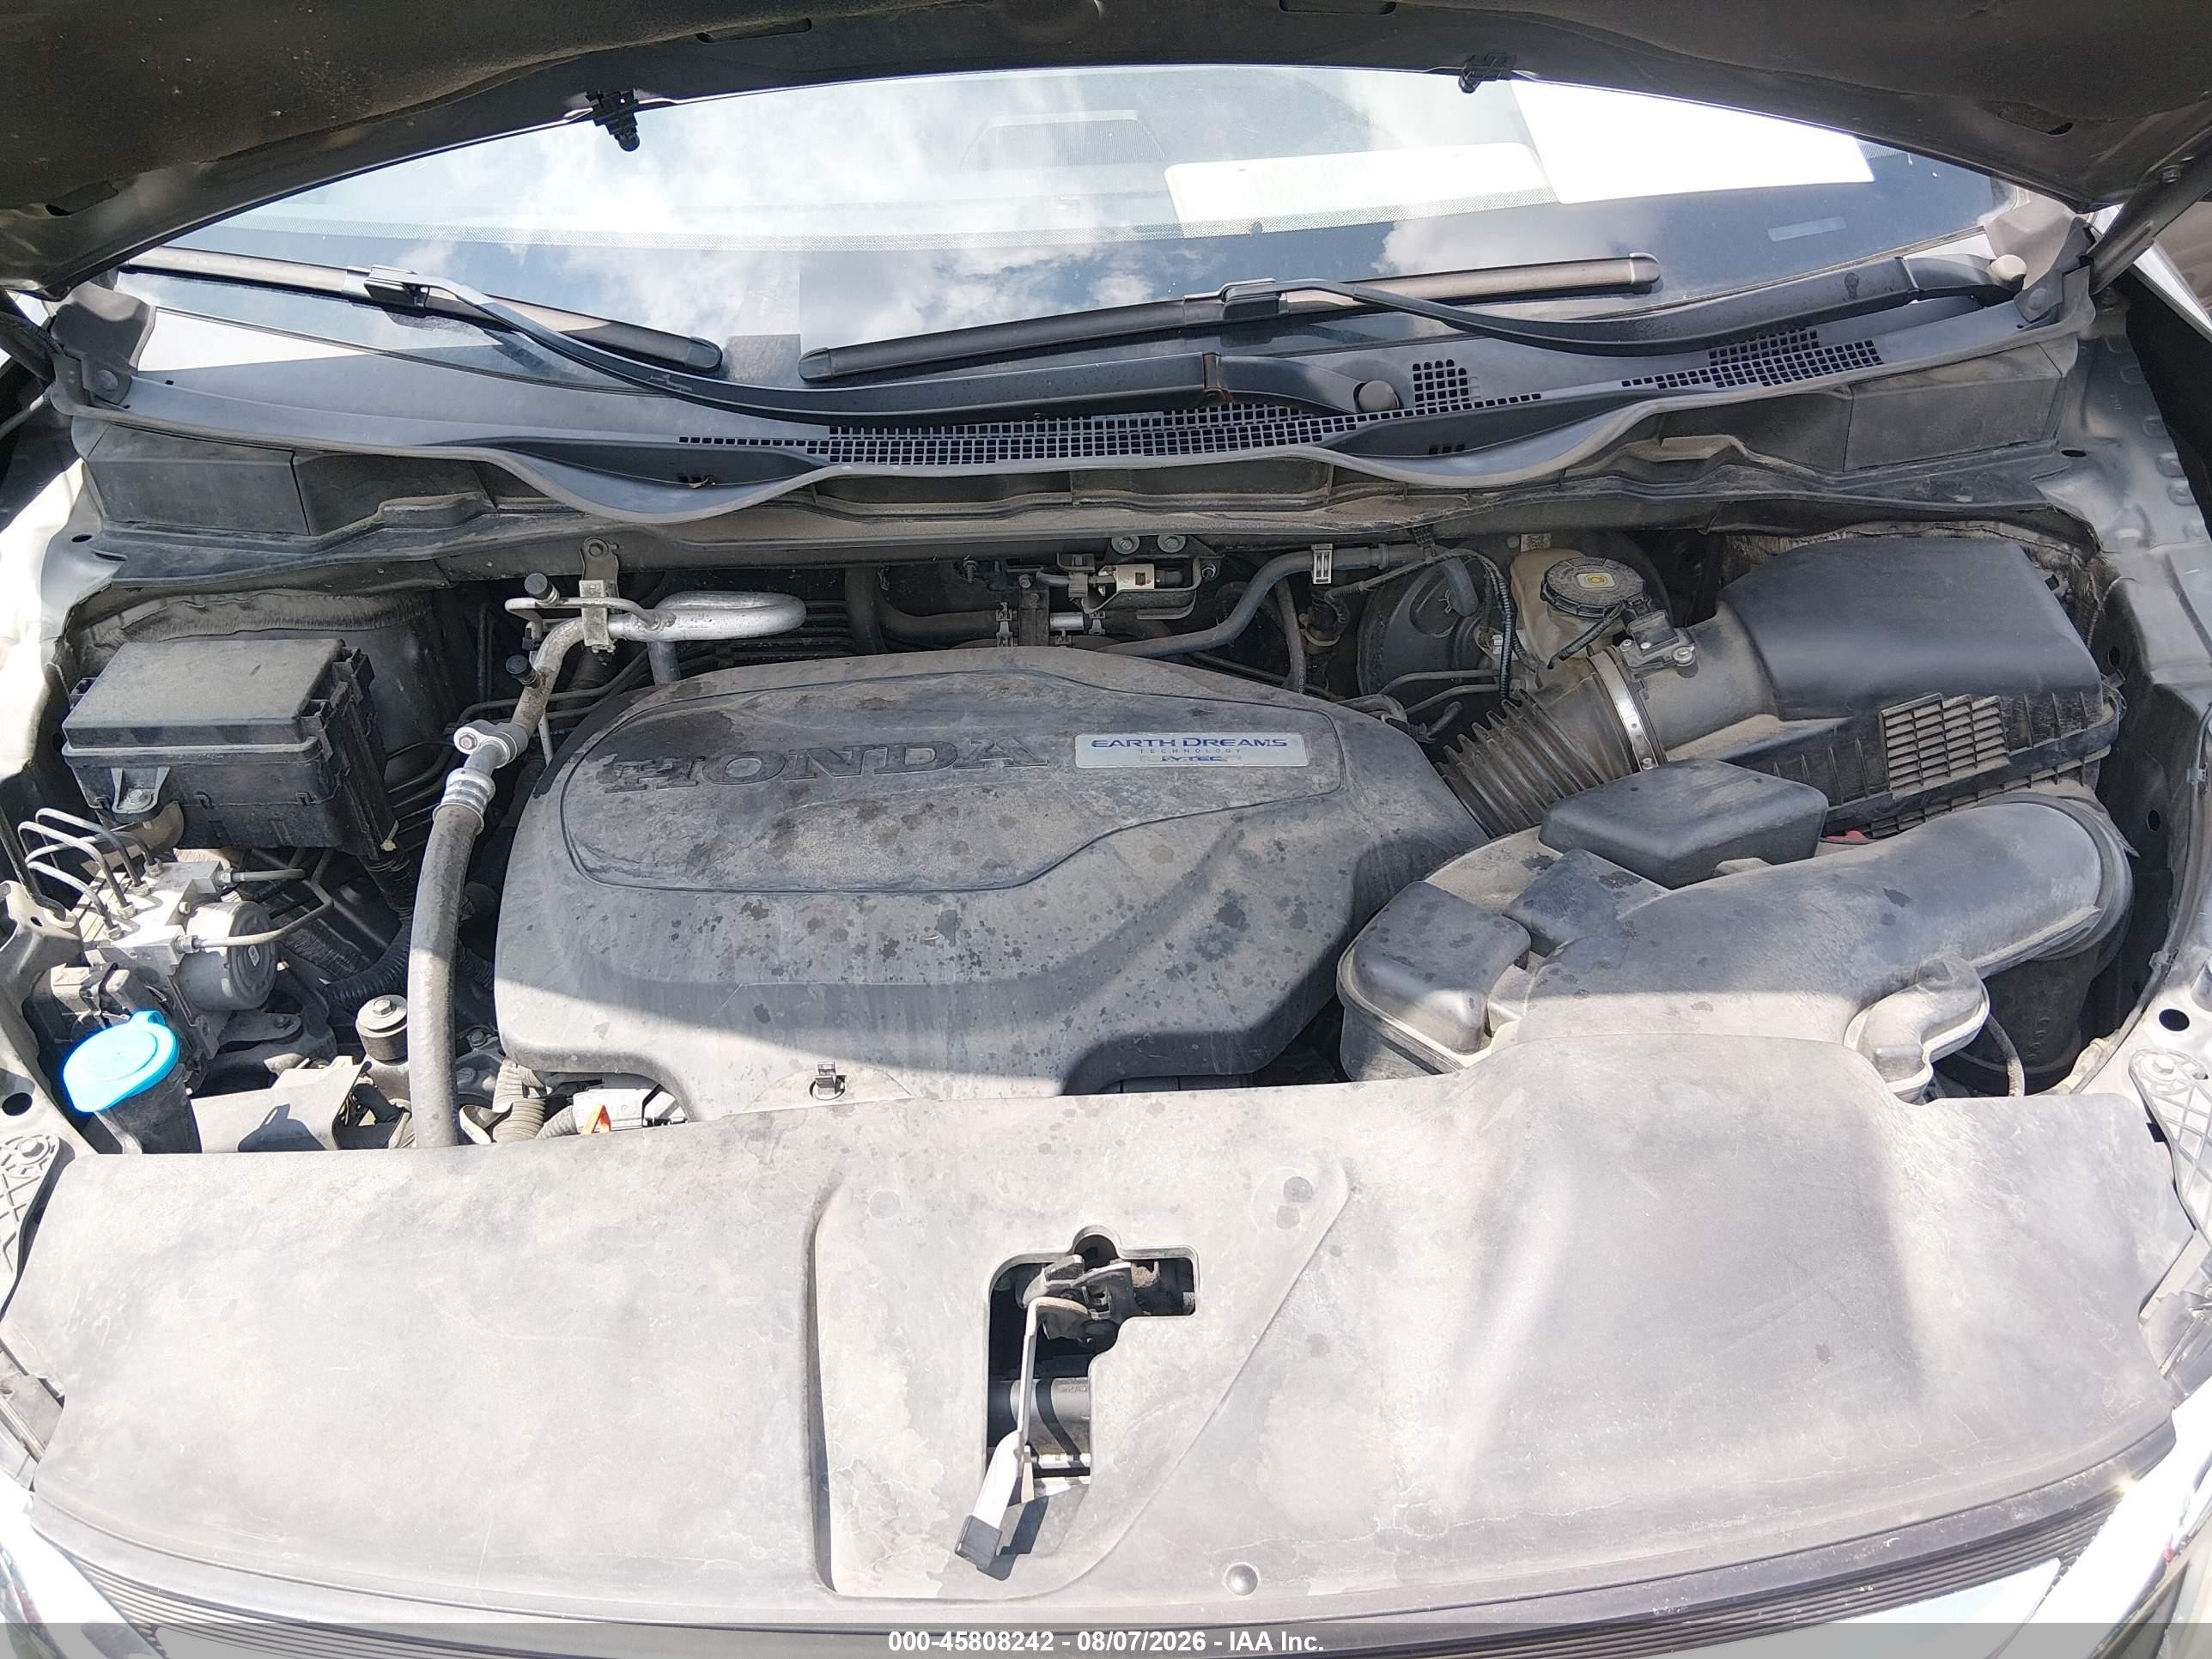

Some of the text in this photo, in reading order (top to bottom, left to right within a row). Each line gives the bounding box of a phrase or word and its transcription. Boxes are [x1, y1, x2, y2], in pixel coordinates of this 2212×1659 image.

[1091, 738, 1287, 748] EARTH DREAMS
[603, 736, 1049, 793] HONDA
